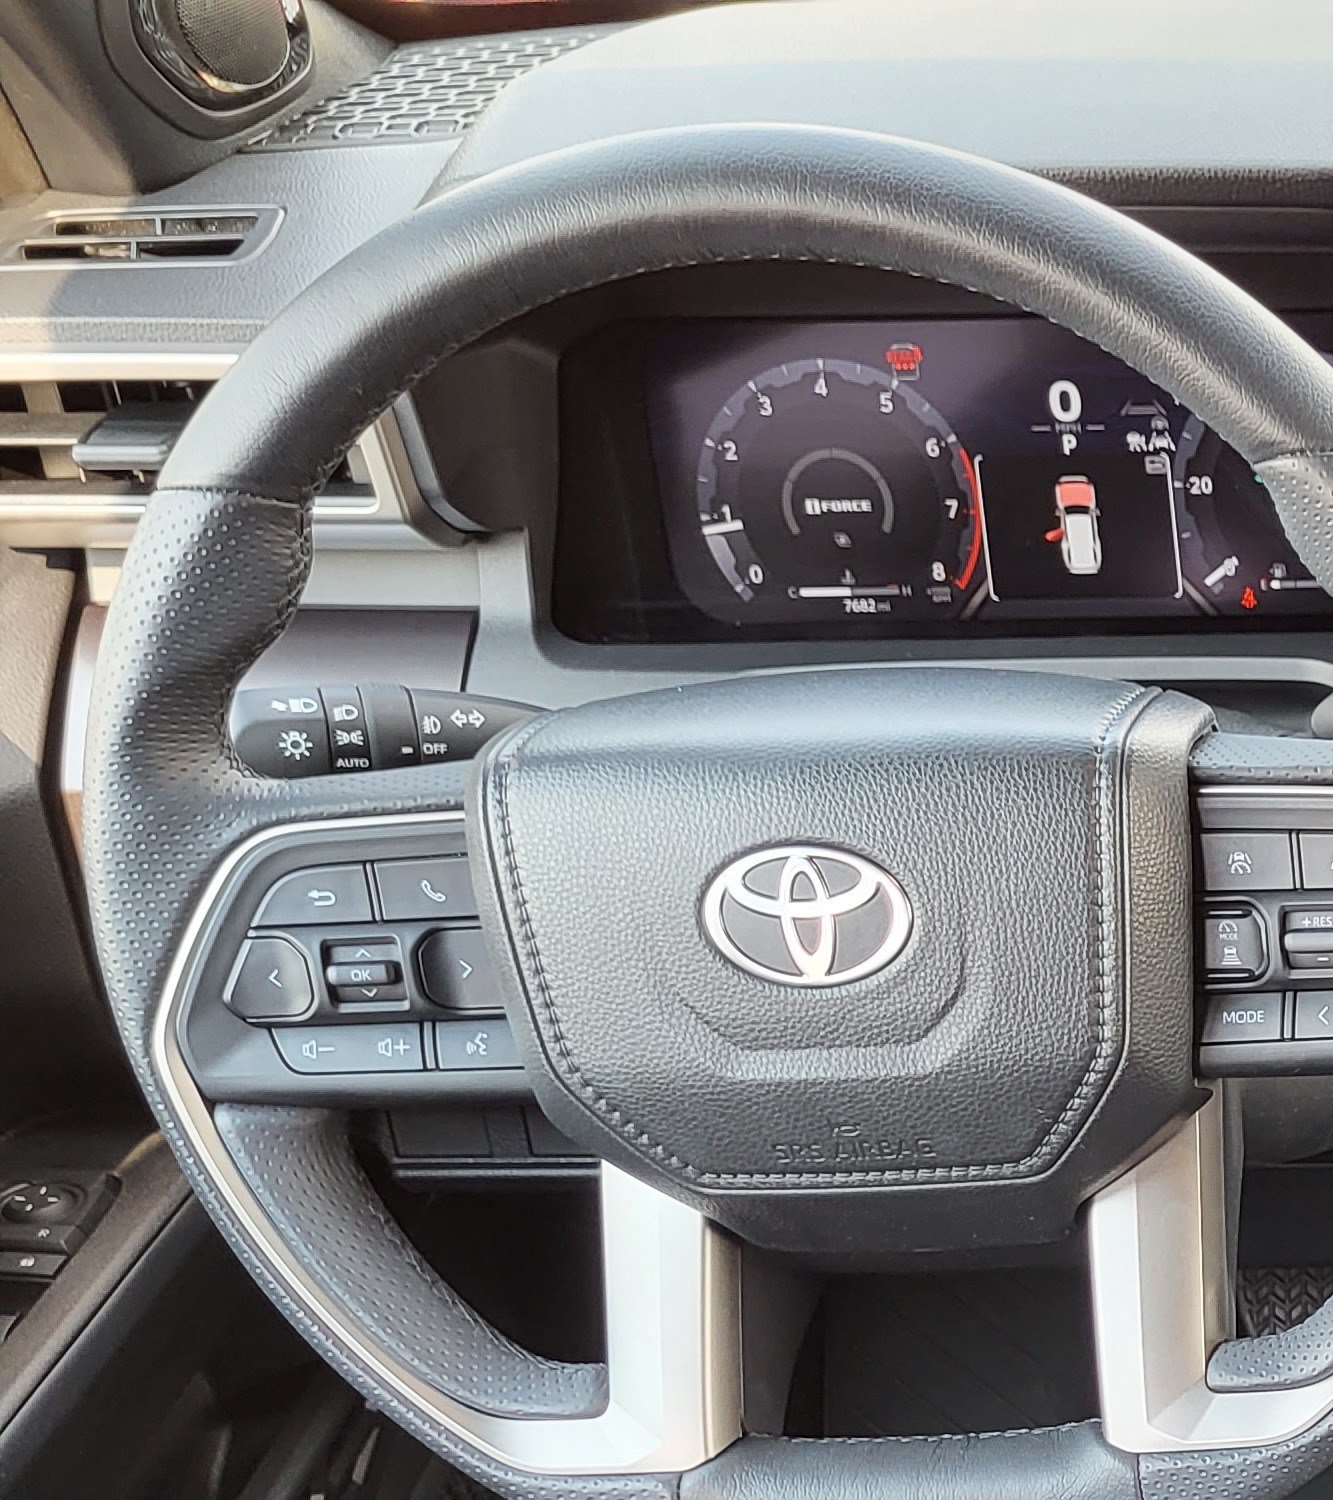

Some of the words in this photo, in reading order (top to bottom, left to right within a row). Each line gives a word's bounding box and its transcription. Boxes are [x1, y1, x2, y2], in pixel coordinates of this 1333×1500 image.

[813, 375, 829, 397] 4
[758, 395, 773, 416] 3
[879, 391, 894, 413] 5
[1048, 379, 1083, 423] 0
[722, 441, 739, 461] 2
[925, 437, 941, 458] 6
[1061, 433, 1078, 456] P
[1189, 475, 1214, 496] 20
[720, 503, 732, 523] 1
[944, 499, 959, 520] 7
[748, 563, 764, 584] 0
[932, 561, 946, 581] 8
[423, 742, 448, 755] OFF
[335, 757, 370, 769] AUTO
[350, 968, 372, 983] OK
[1222, 1010, 1265, 1024] MODE
